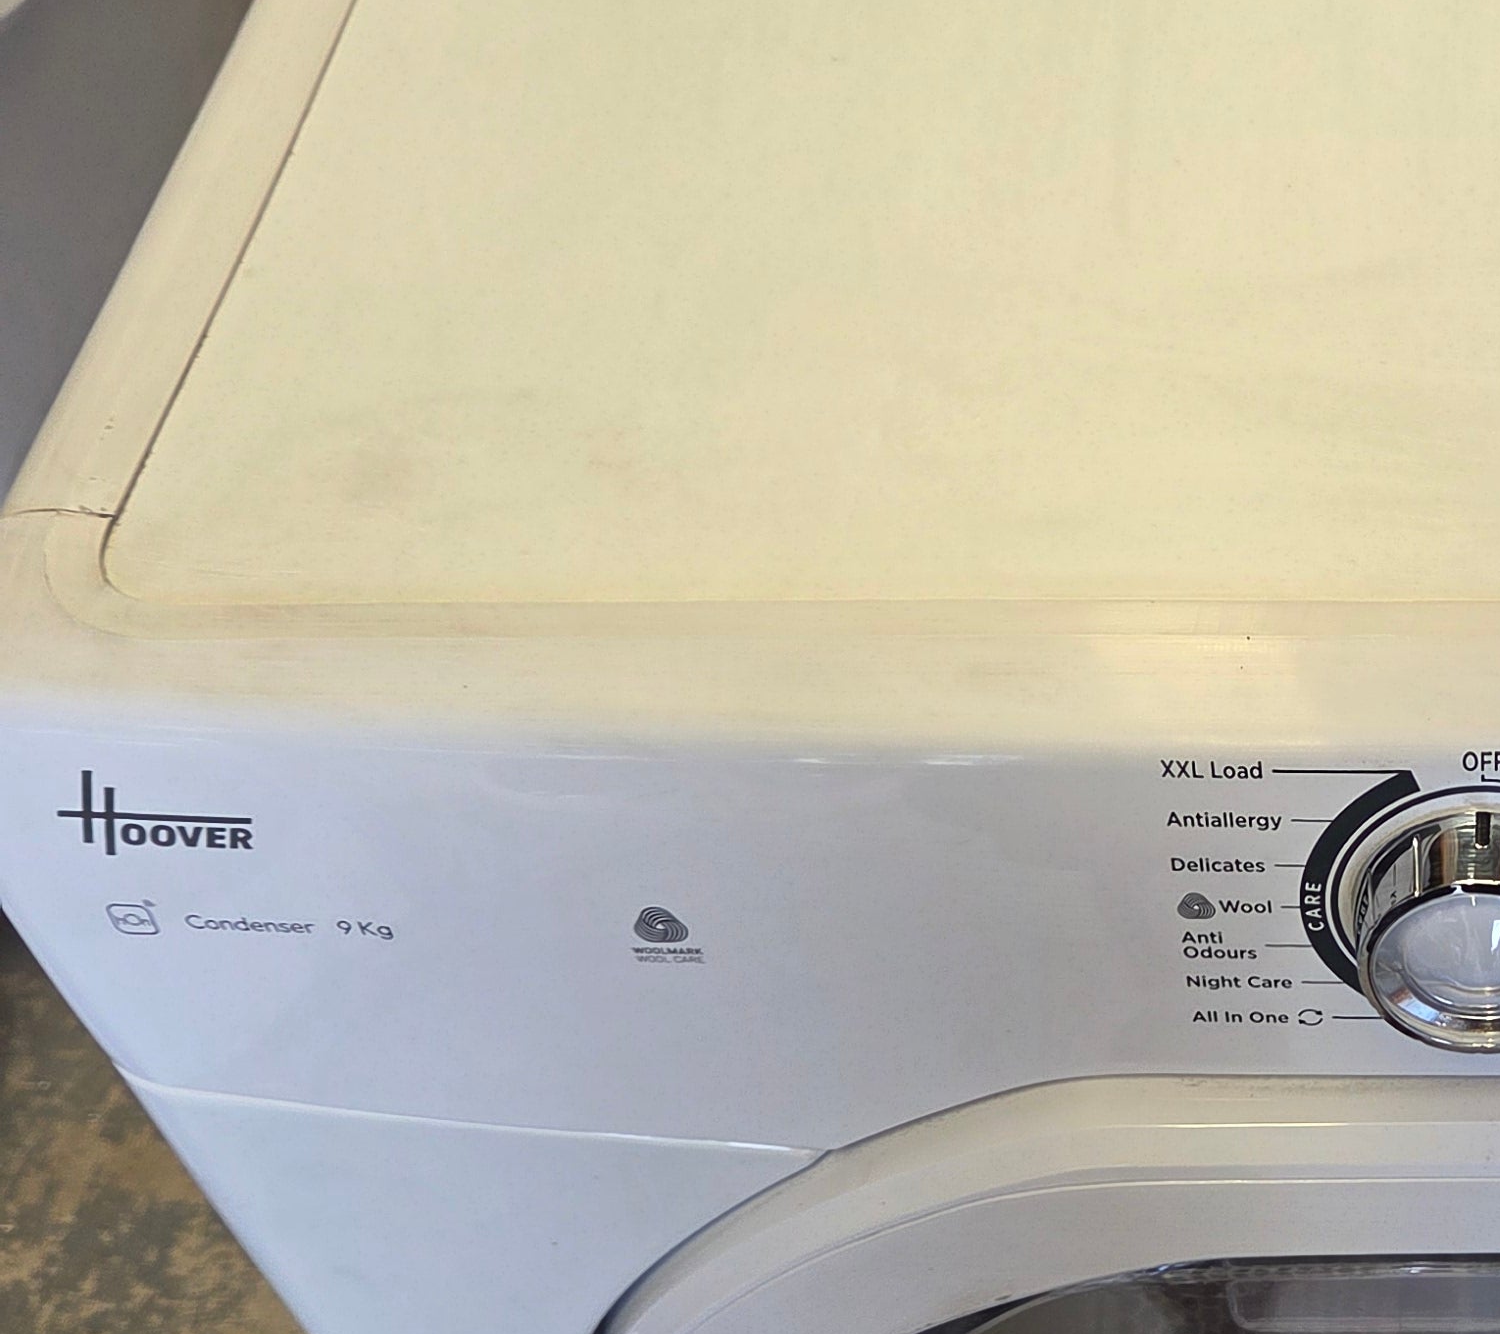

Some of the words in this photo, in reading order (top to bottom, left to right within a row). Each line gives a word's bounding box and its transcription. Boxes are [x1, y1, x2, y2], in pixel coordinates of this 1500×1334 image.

[1160, 761, 1204, 779] XXL
[1211, 761, 1263, 779] Load
[57, 770, 254, 855] HOOVER
[1167, 812, 1282, 830] Antiallergy
[1171, 857, 1266, 873] Delicates
[1219, 900, 1273, 914] Wool
[1304, 881, 1325, 931] CARE
[185, 914, 315, 934] Condenser
[1181, 931, 1223, 944] Anti
[631, 947, 704, 955] WOOLMARK
[1183, 946, 1257, 960] Odours
[635, 955, 671, 963] WOOL
[1186, 975, 1241, 990] Night
[1247, 976, 1293, 989] Care
[1192, 1011, 1218, 1023] All
[1225, 1011, 1242, 1023] In
[1250, 1011, 1289, 1024] One
